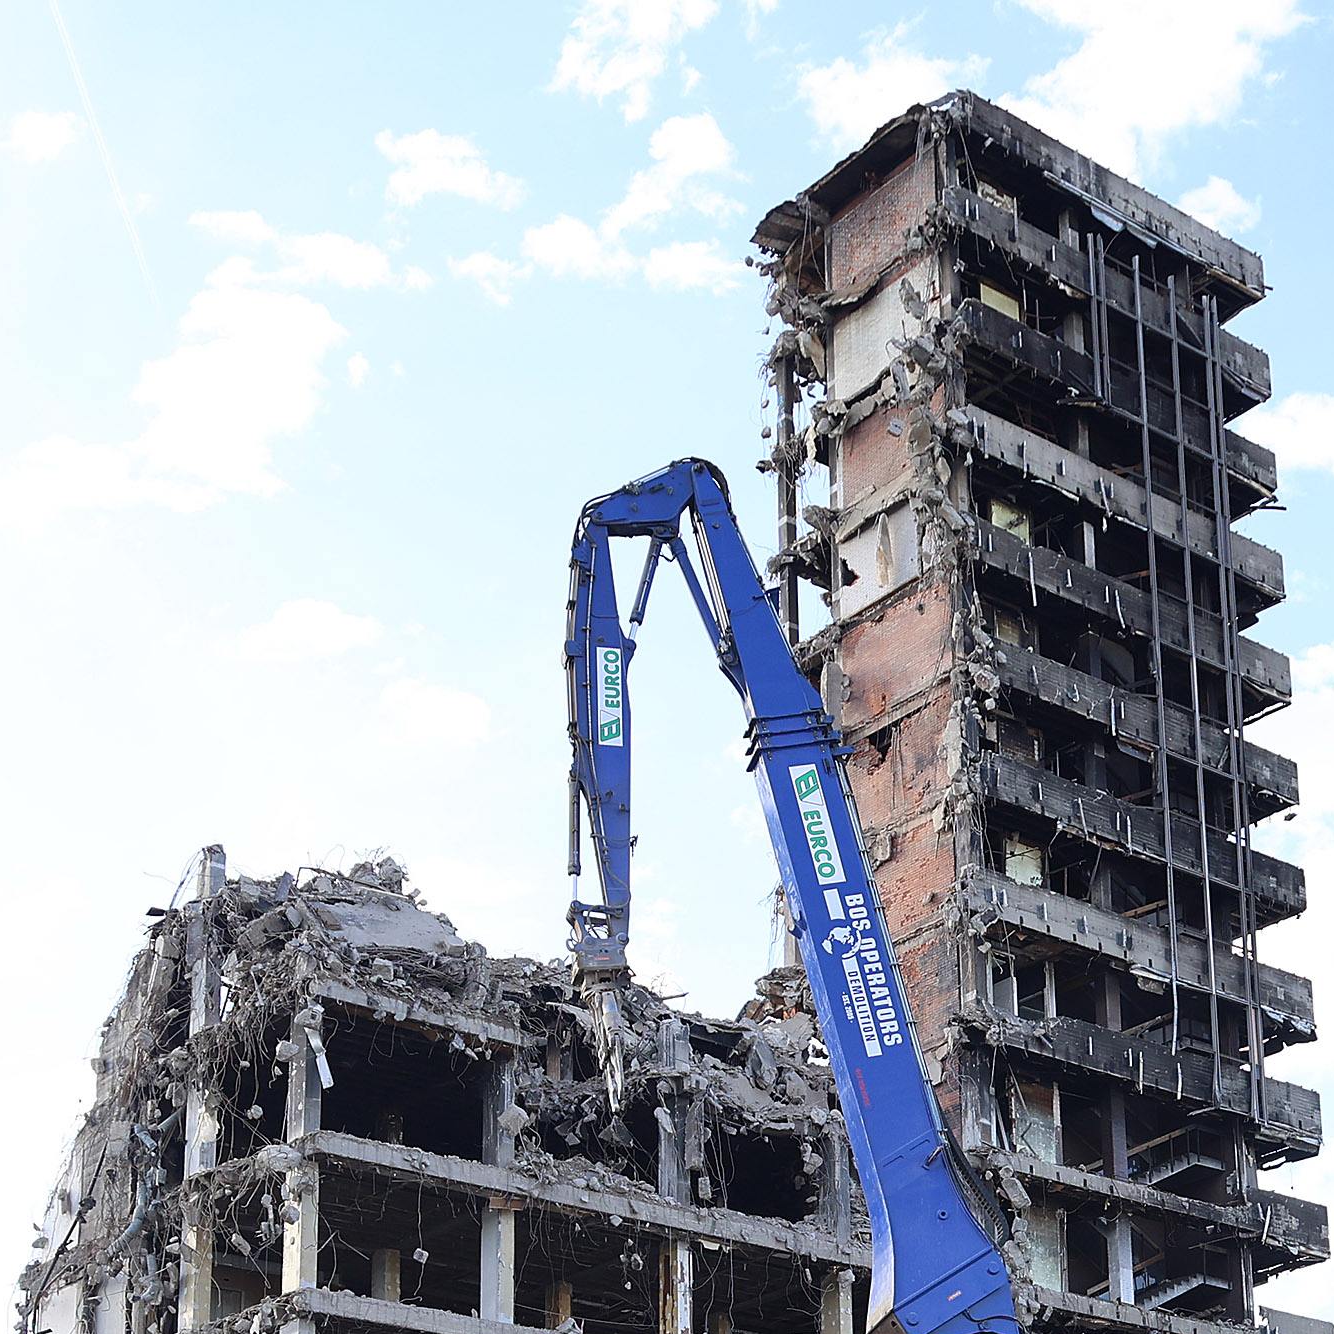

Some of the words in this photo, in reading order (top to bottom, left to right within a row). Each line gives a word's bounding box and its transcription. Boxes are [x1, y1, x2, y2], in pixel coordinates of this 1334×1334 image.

[603, 650, 621, 709] EURCO
[803, 810, 836, 878] EURCO
[844, 893, 872, 932] BOS
[859, 937, 904, 1047] OPERATORS
[847, 970, 877, 1042] DEMOLITION
